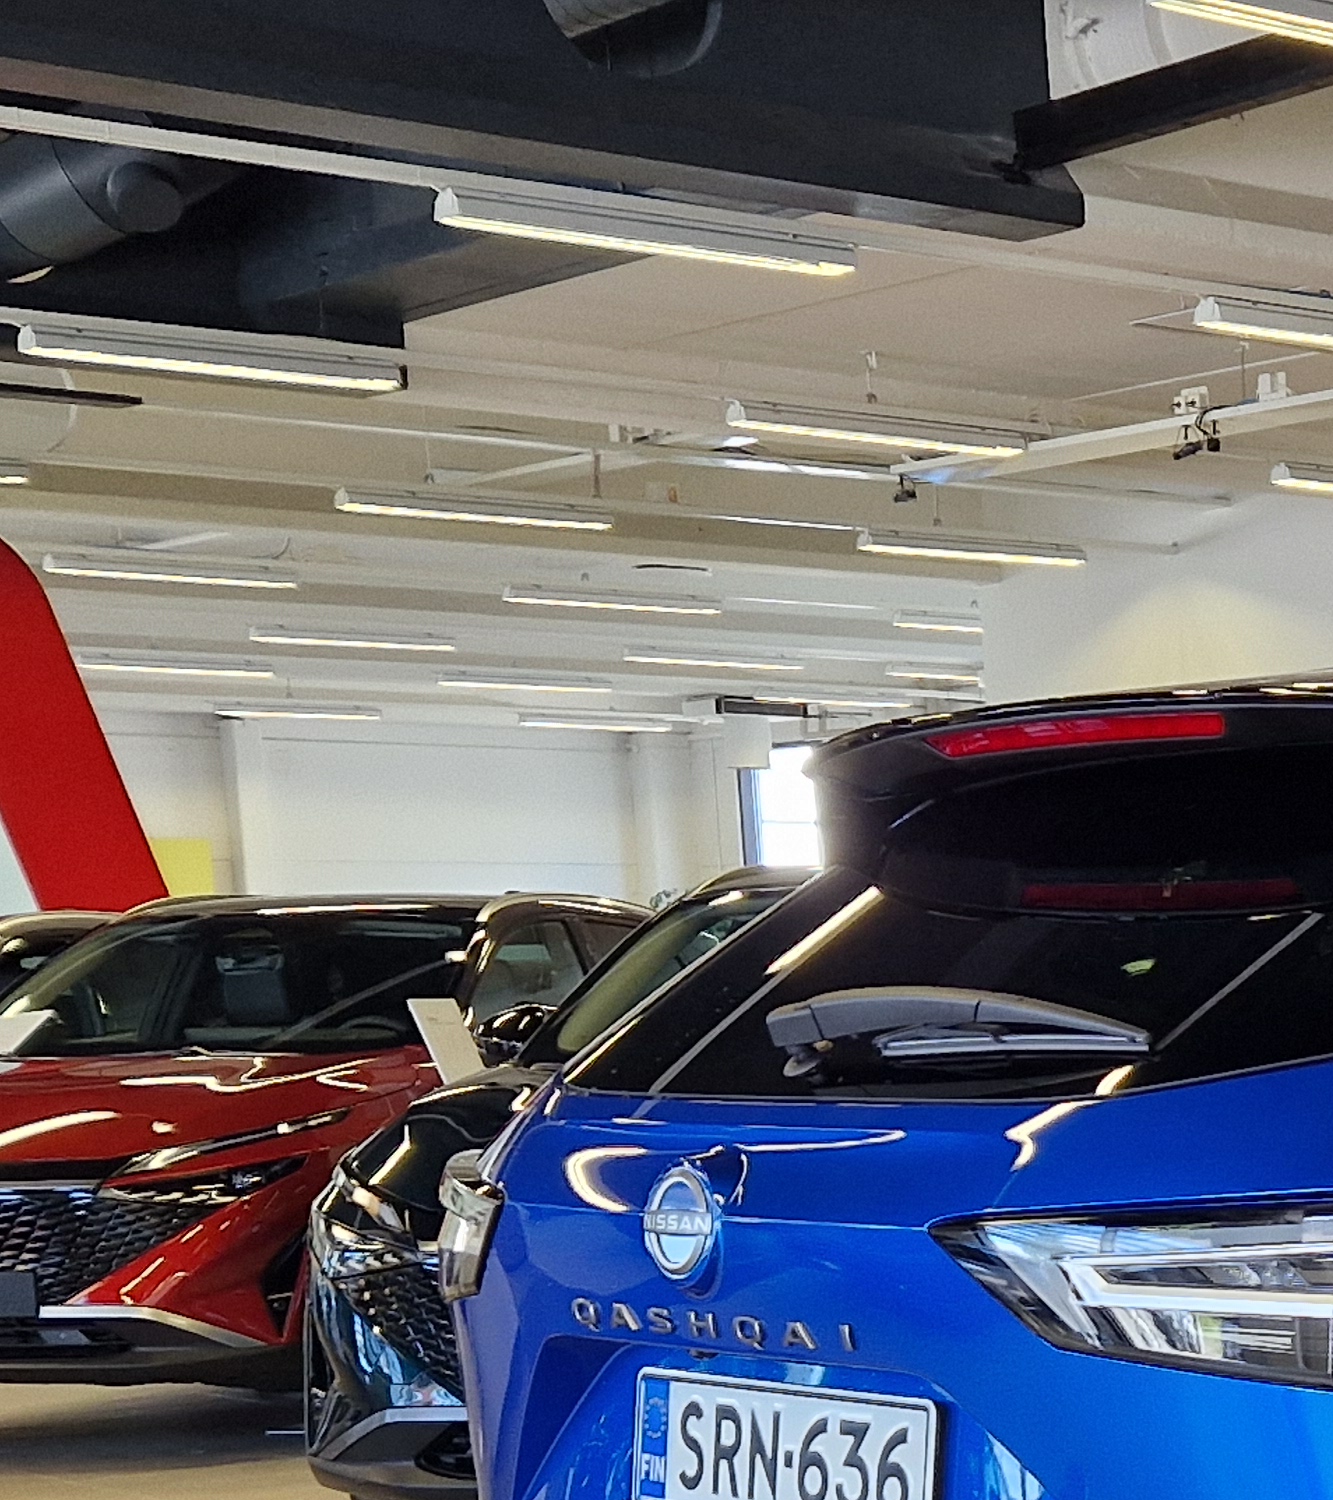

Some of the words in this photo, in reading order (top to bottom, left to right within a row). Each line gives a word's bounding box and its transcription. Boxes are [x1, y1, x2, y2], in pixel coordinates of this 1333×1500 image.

[644, 1213, 710, 1232] NISSAN
[571, 1297, 855, 1351] QASHQAI
[642, 1452, 666, 1483] FIN
